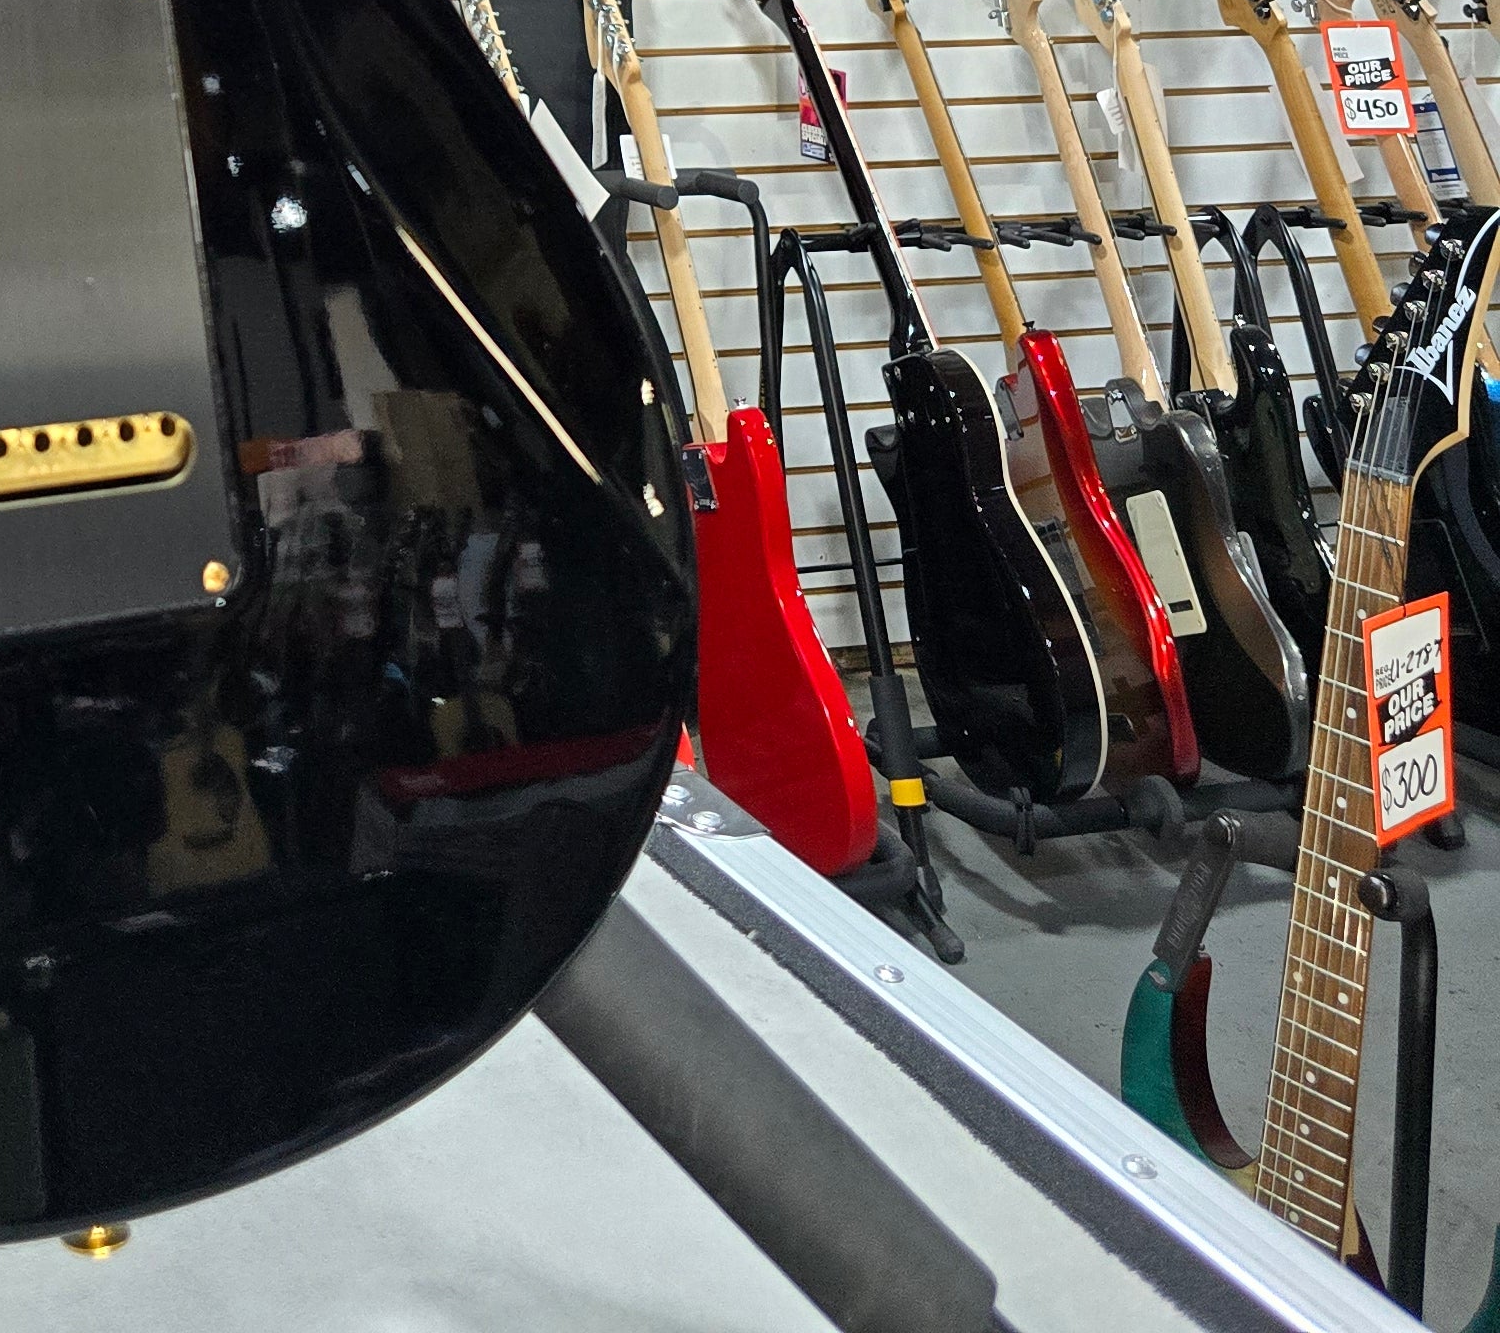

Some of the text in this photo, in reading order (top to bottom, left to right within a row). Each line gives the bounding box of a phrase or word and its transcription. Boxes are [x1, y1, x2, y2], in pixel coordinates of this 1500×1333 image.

[1344, 69, 1392, 86] PRICE
[1347, 60, 1382, 74] OUR
[1344, 97, 1399, 121] $450
[1402, 284, 1477, 379] Ibanez
[1388, 678, 1424, 717] OUR
[1384, 691, 1435, 744] PRICE
[1381, 753, 1438, 816] $300
